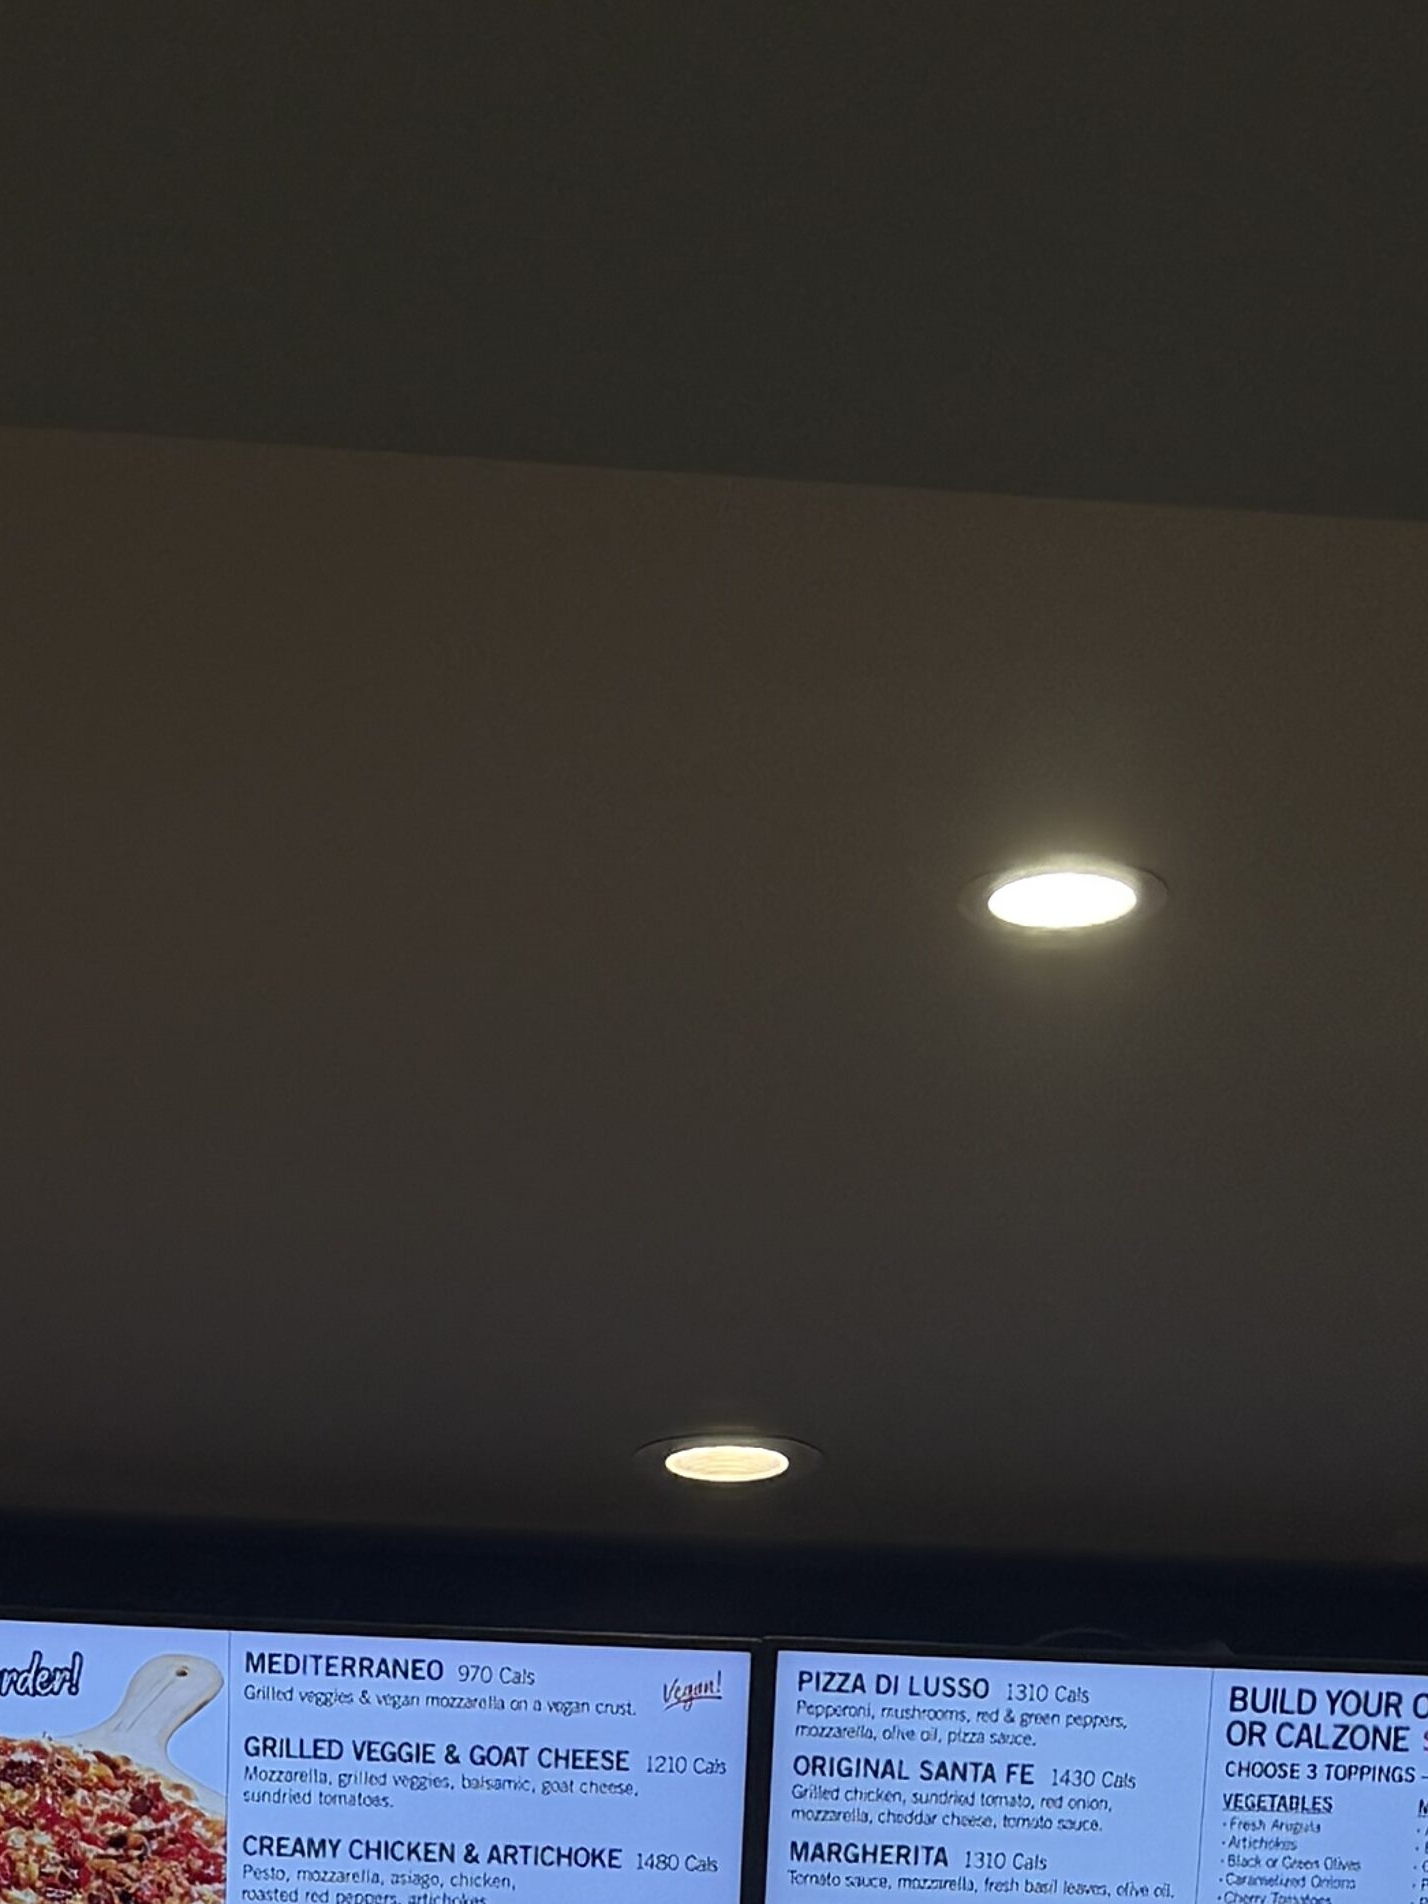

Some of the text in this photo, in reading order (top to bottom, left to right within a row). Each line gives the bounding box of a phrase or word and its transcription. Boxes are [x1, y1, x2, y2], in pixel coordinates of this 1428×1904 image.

[245, 1654, 535, 1686] MEDITERRANEO 970 Cals
[663, 1670, 723, 1712] Vegan!
[797, 1671, 1089, 1704] PIZZA DI LUSSO 1310 Cals
[1229, 1686, 1317, 1715] BUILD
[1325, 1689, 1403, 1718] YOUR
[1225, 1720, 1267, 1747] OR
[1275, 1722, 1411, 1752] CALZONE
[243, 1737, 727, 1775] GRILLED VEGGIE & GOAT CHEESE 1210 Cals
[792, 1755, 1136, 1789] ORIGINAL SANTA FE 1430 Cals
[1225, 1760, 1300, 1780] CHOOSE
[1306, 1763, 1317, 1781] 3
[1324, 1763, 1416, 1783] TOPPINGS
[1222, 1793, 1333, 1815] VEGETABLES
[242, 1836, 718, 1873] CREAMY CHICKEN & ARTICHOKE 1480 Cals
[789, 1841, 1047, 1871] MARGHERITA 1310 Cals
